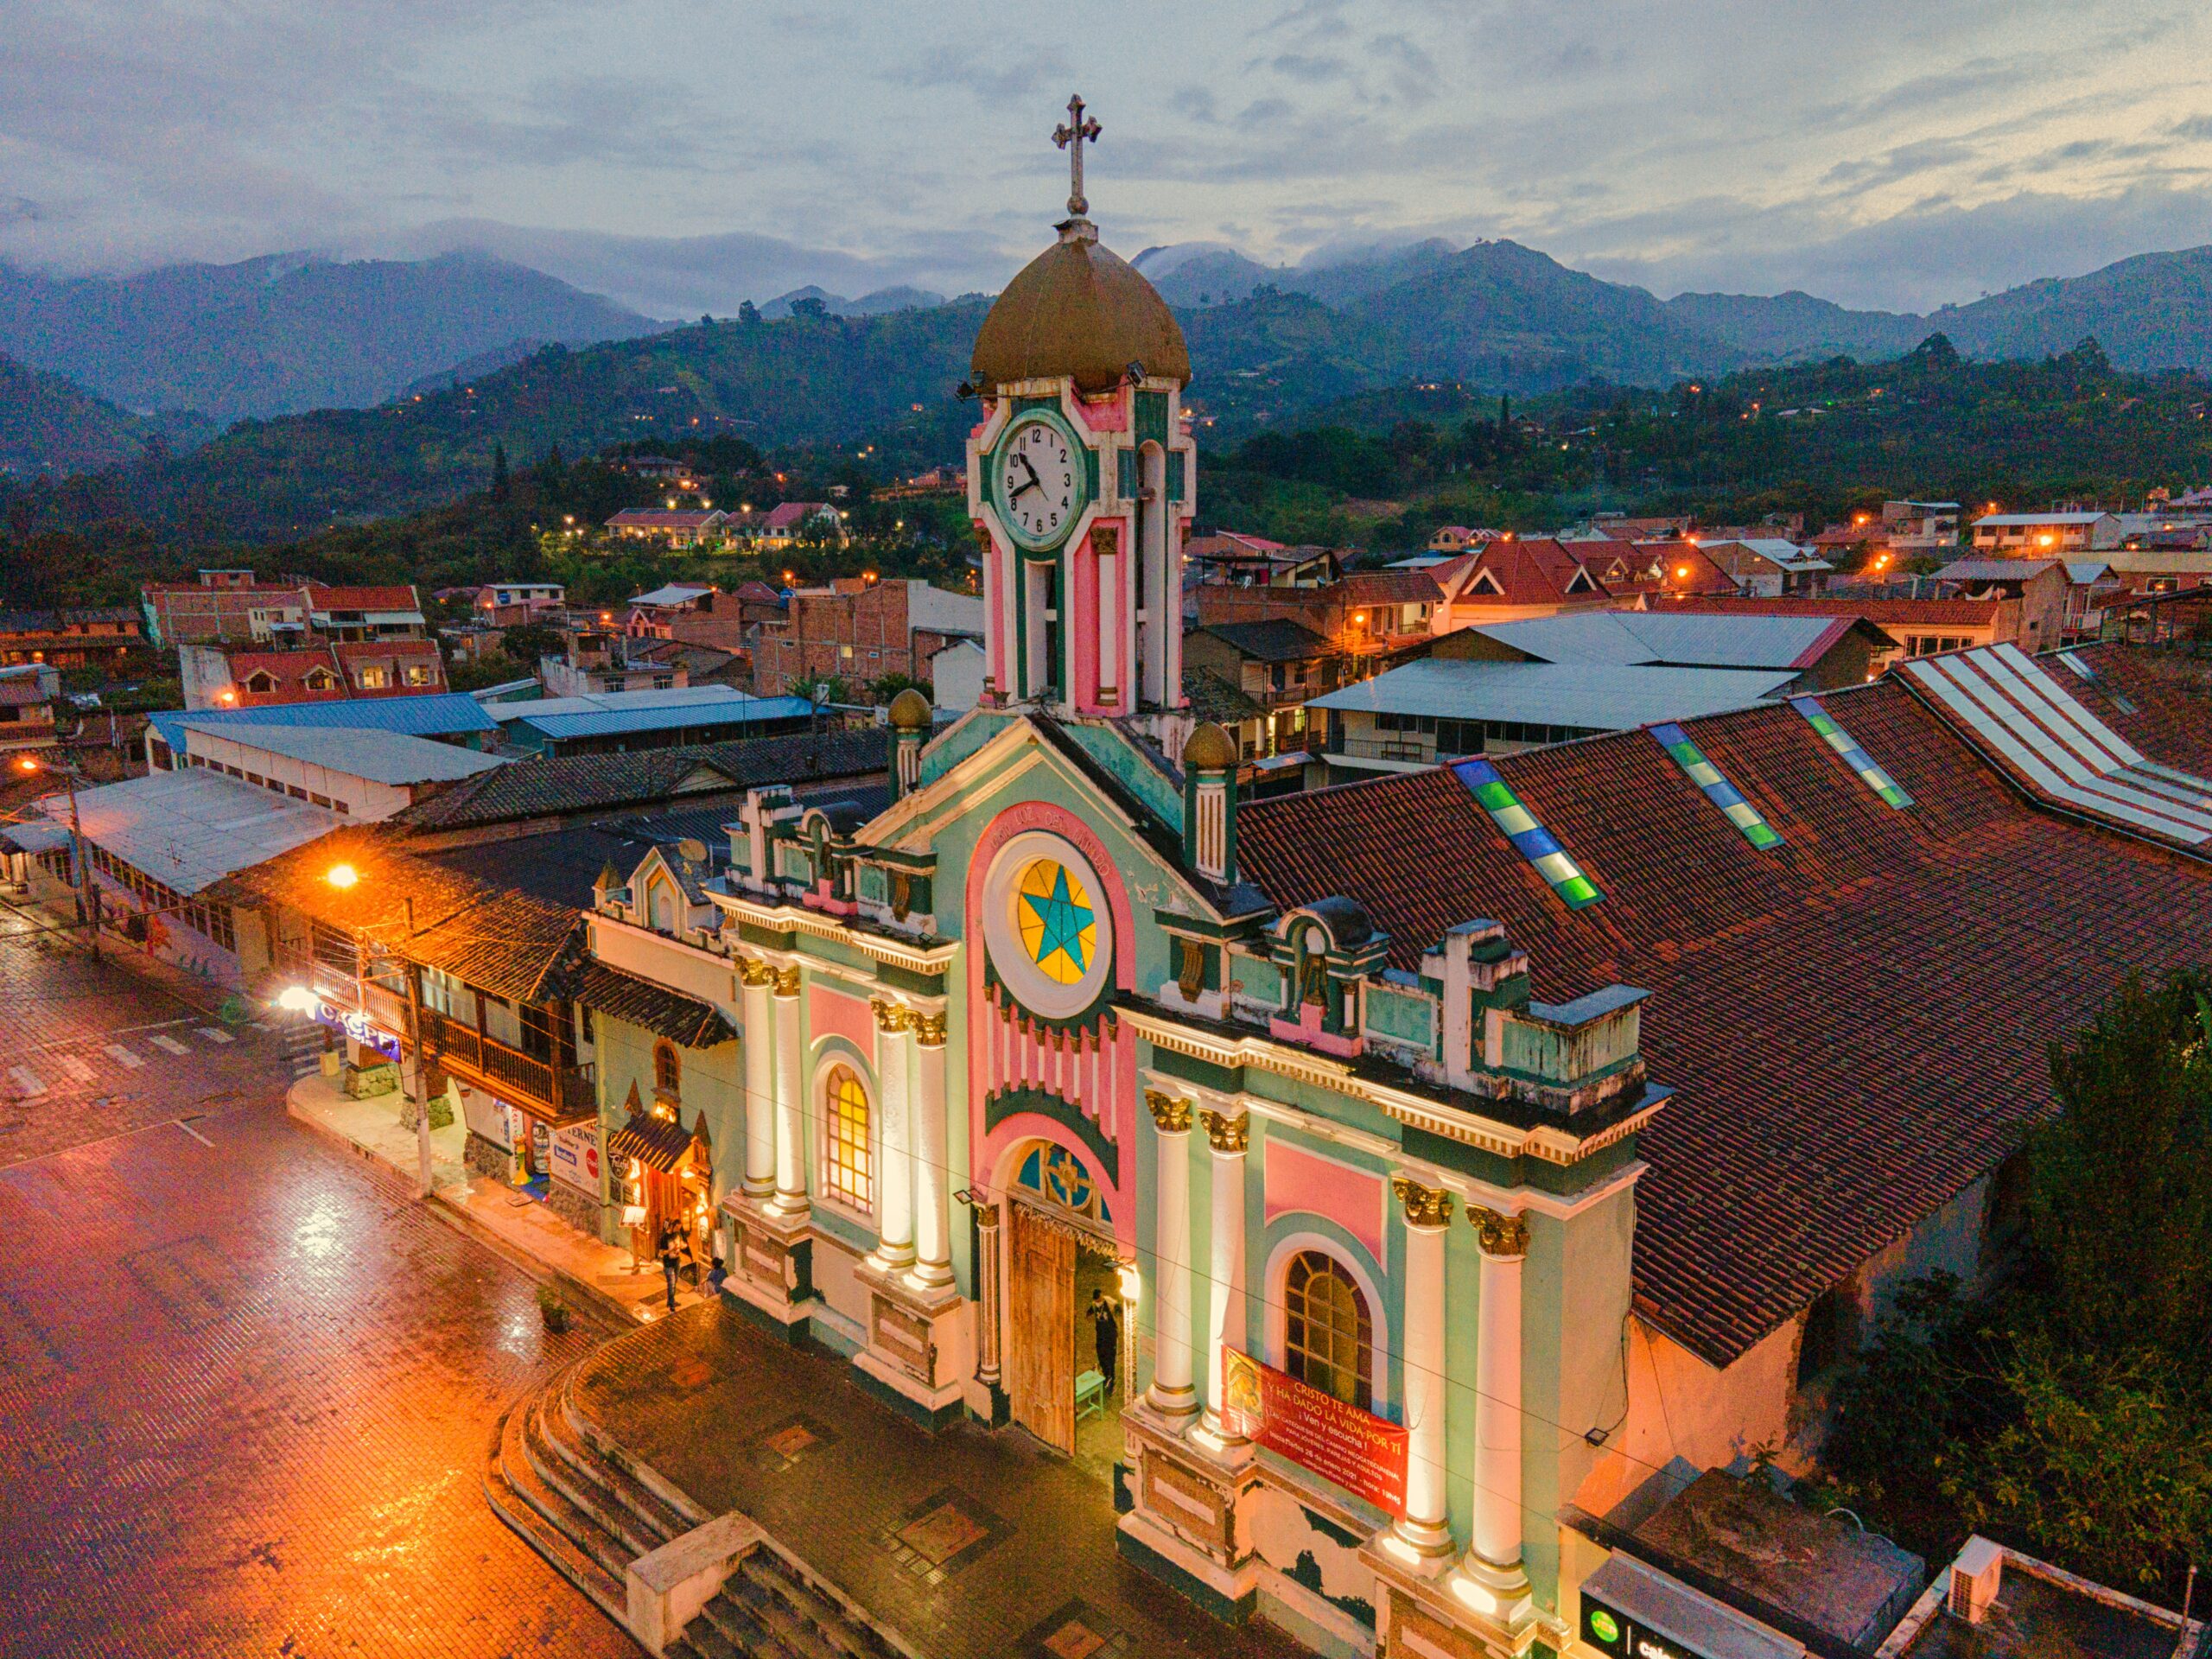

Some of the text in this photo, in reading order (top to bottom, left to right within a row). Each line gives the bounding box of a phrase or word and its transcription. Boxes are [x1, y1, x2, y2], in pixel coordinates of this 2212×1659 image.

[1033, 429, 1041, 443] 12
[1050, 434, 1053, 448] 1
[1020, 437, 1026, 451] 11
[1010, 454, 1019, 467] 10
[1060, 449, 1066, 463] 2
[1007, 475, 1014, 489] 9
[1064, 474, 1071, 487] 3
[1011, 498, 1017, 511] 8
[1061, 496, 1068, 509] 4
[1023, 512, 1028, 526] 7
[1037, 519, 1043, 532] 6
[1051, 513, 1058, 526] 5
[1294, 1382, 1370, 1425] CRISTO TE AMA
[1268, 1382, 1274, 1392] Y
[1276, 1386, 1291, 1401] HA
[1294, 1395, 1322, 1415] DADO
[1325, 1409, 1337, 1424] LA
[1339, 1417, 1364, 1439] VIDA
[1366, 1430, 1389, 1450] POR
[1303, 1411, 1319, 1427] Ven
[1321, 1422, 1326, 1432] y
[1328, 1426, 1363, 1449] escucha
[1357, 1464, 1382, 1481] ADULTOS
